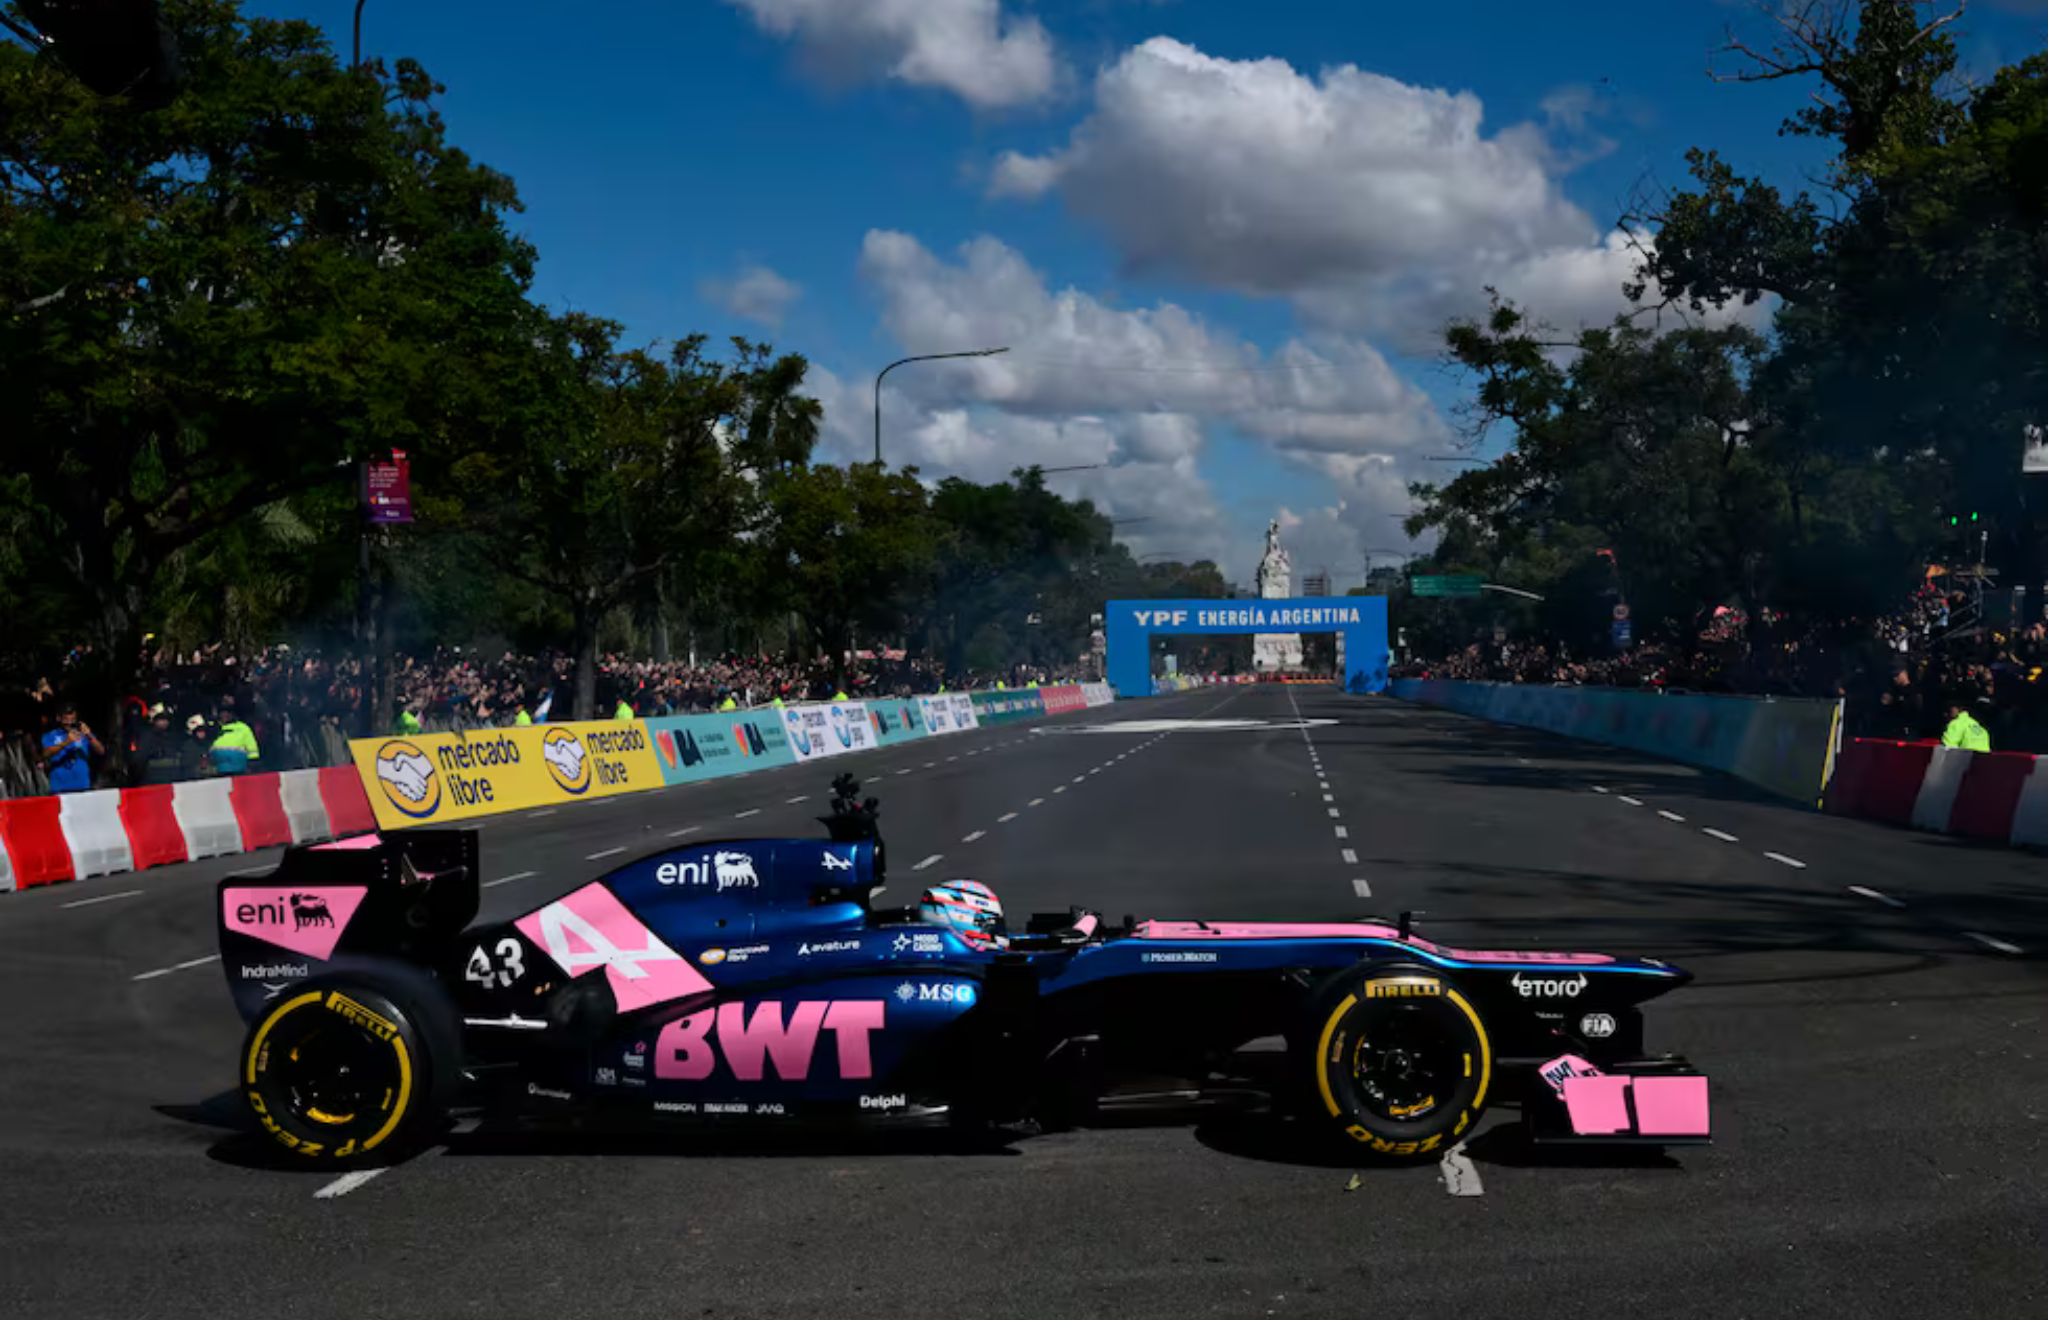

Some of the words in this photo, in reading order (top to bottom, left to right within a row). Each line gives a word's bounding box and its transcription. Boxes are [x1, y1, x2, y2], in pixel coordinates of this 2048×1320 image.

[1133, 610, 1188, 627] YPF
[1198, 606, 1266, 627] ENERGÍA
[1270, 607, 1361, 626] ARGENTINA
[437, 734, 521, 771] mercado
[586, 725, 645, 754] mercado
[593, 757, 628, 786] libre
[446, 774, 495, 806] libre
[656, 854, 710, 885] eni
[236, 895, 286, 925] eni
[810, 939, 861, 953] avature
[242, 963, 308, 979] IndraMind
[465, 937, 525, 989] 43
[918, 983, 975, 1001] MSC
[1366, 977, 1442, 999] PIRELLI
[325, 991, 399, 1041] PIRELLI
[1582, 1017, 1611, 1032] FIA
[654, 999, 886, 1081] BWT
[860, 1094, 905, 1109] Delphi
